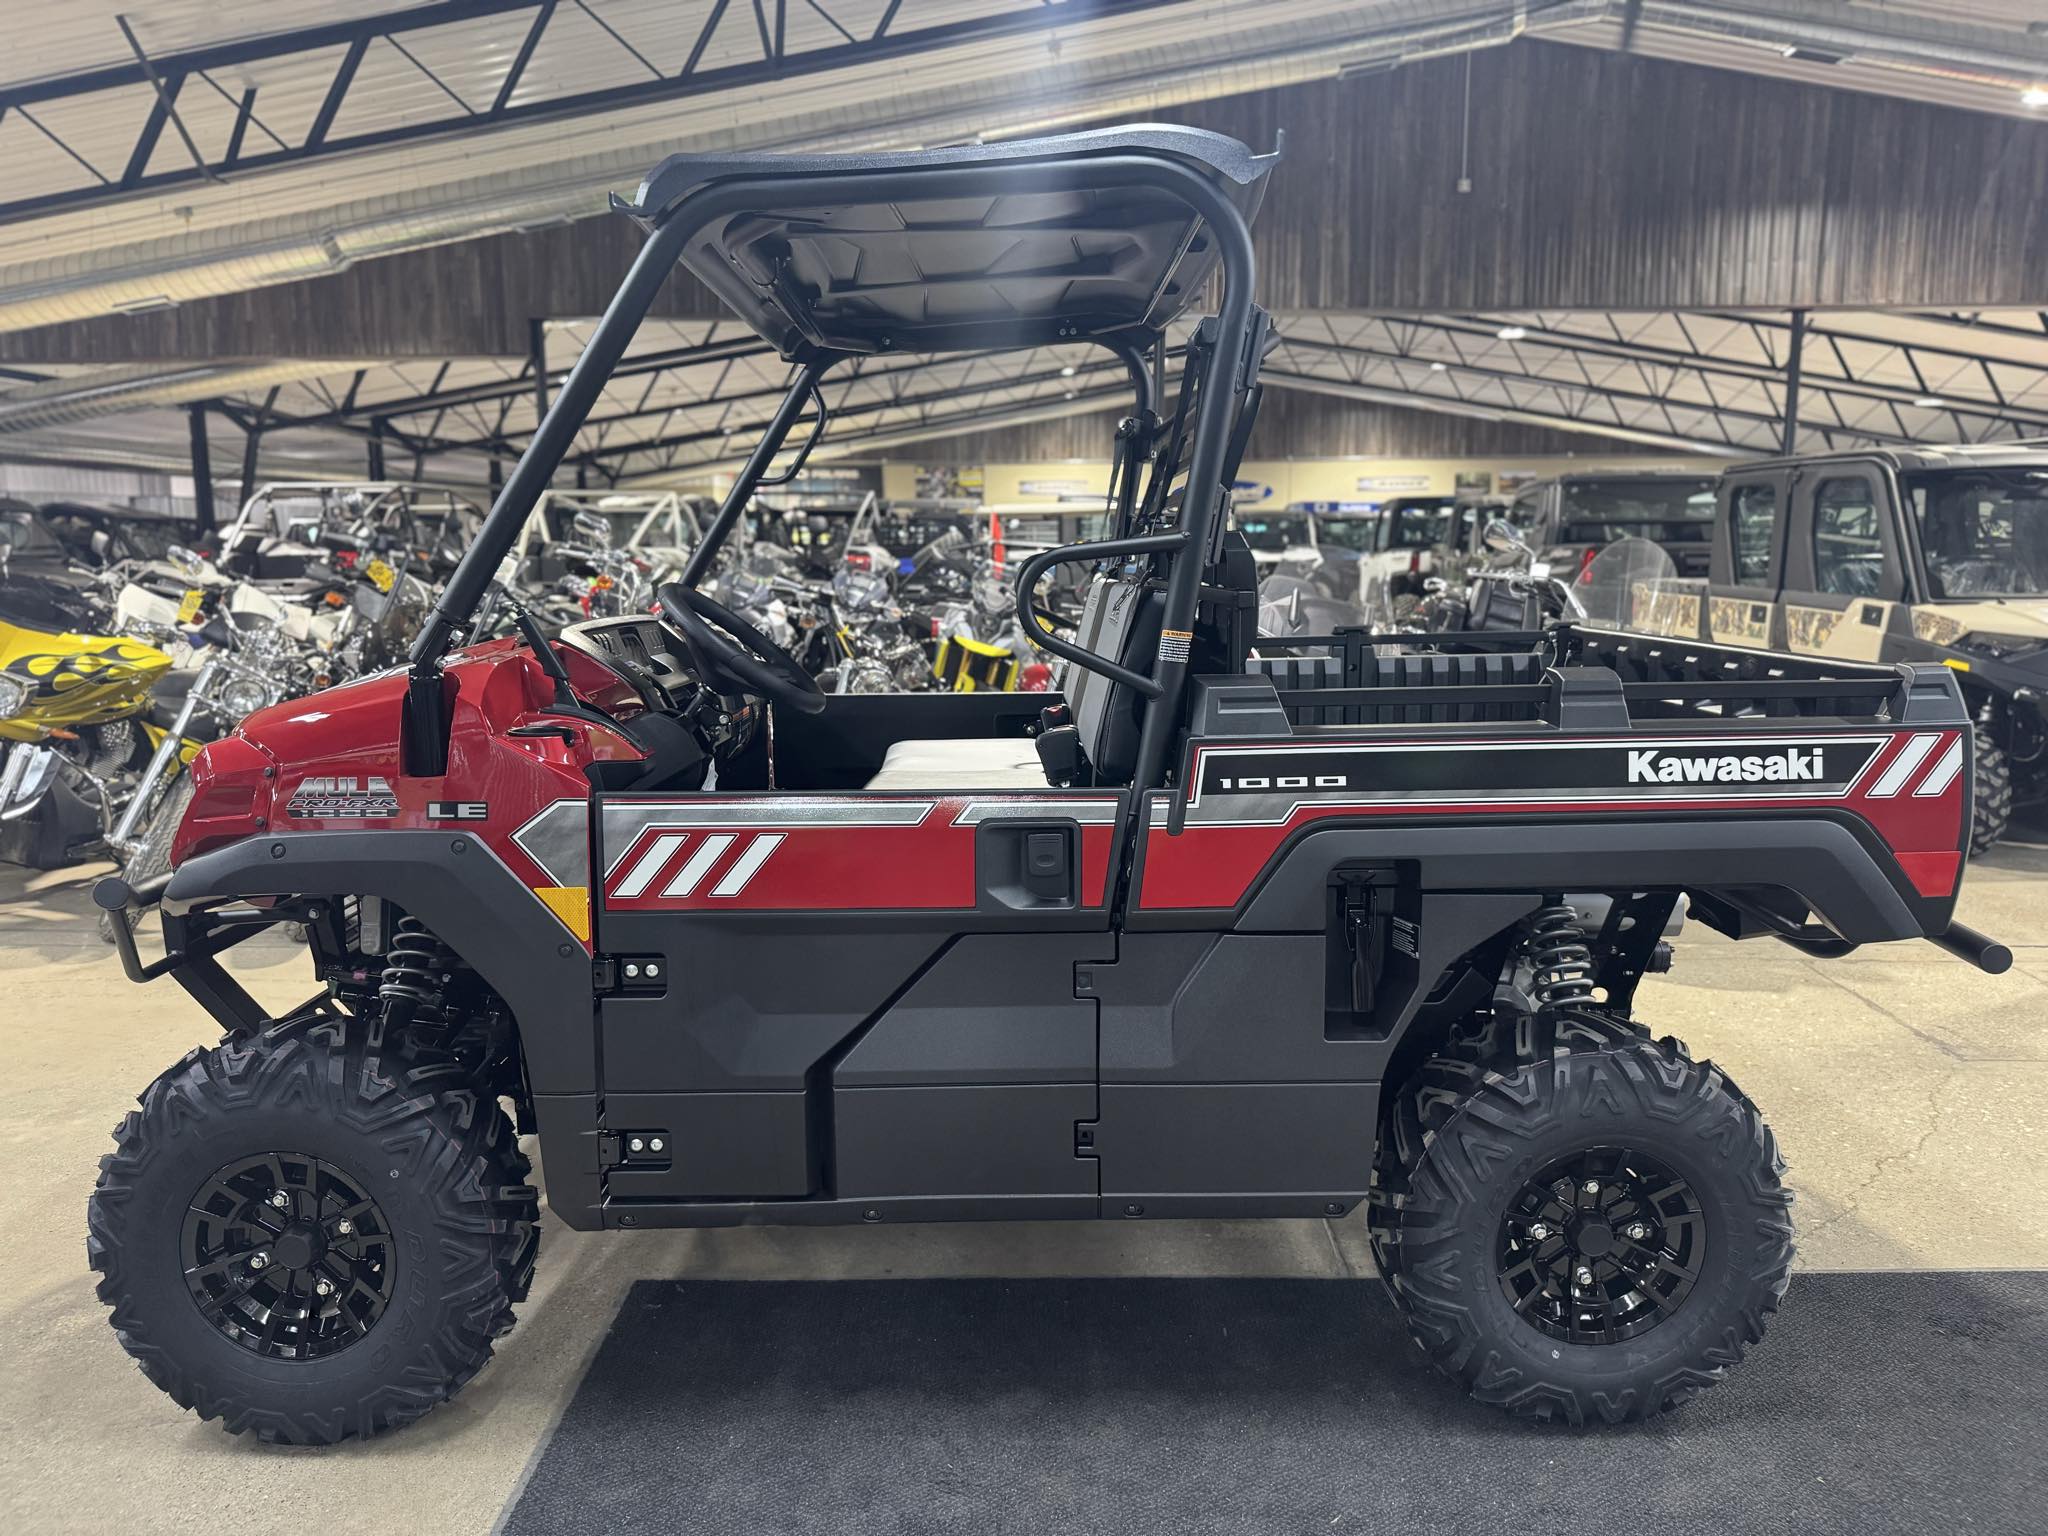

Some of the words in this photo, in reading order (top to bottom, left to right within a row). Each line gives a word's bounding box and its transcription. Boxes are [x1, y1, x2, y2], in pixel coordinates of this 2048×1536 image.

[1628, 747, 1824, 783] Kawasaki
[291, 776, 396, 798] MULE
[1219, 775, 1347, 789] 1000
[428, 803, 487, 818] LE
